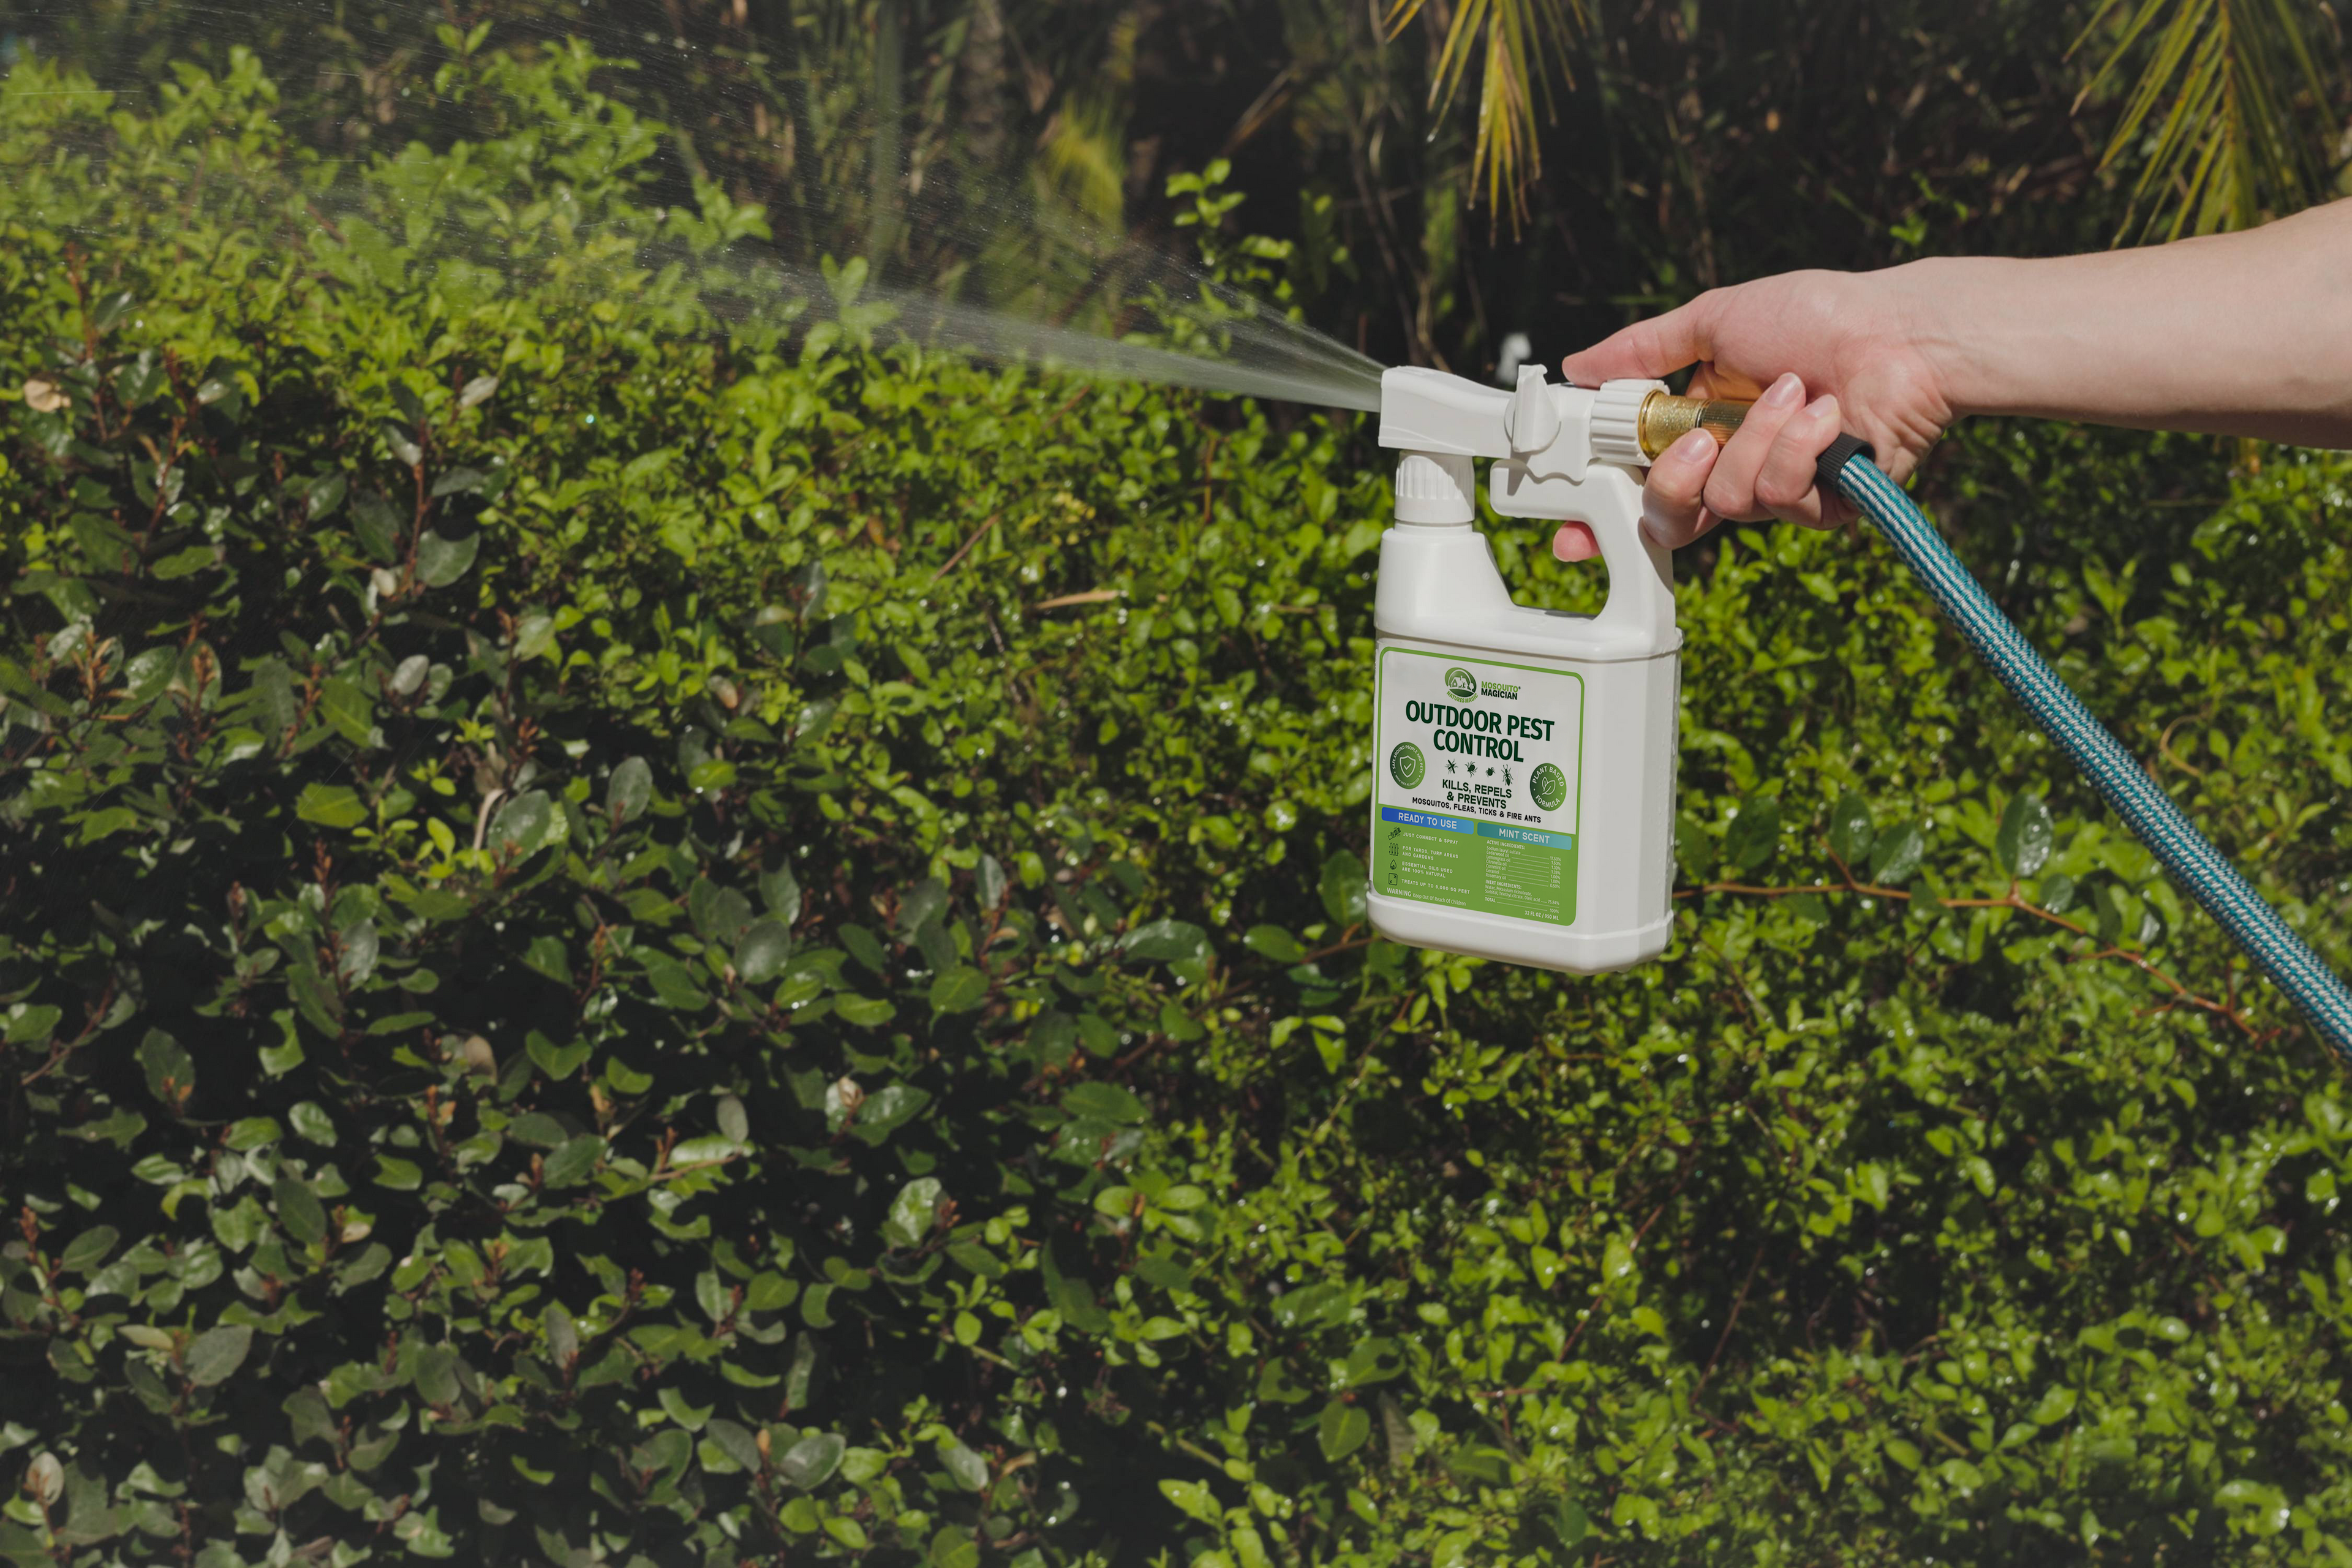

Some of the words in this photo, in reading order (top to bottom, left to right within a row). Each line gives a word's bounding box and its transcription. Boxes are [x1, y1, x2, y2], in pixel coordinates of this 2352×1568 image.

[1447, 691, 1464, 703] NATURES
[1465, 693, 1478, 703] MAGIC
[1481, 688, 1517, 700] MAGICIAN
[1406, 700, 1502, 734] OUTDOOR
[1507, 715, 1555, 741] PEST
[1394, 745, 1405, 758] AROUND
[1405, 745, 1418, 754] PEOPLE
[1434, 729, 1524, 762] CONTROL
[1532, 766, 1547, 784] PLANT
[1549, 766, 1564, 786] BASED
[1442, 779, 1471, 793] KILLS,
[1475, 784, 1512, 798] REPELS
[1412, 797, 1451, 810] MOSQUITOS,
[1454, 804, 1476, 814] FLEAS,
[1479, 808, 1497, 816] TICKS
[1447, 792, 1454, 801] &
[1458, 793, 1506, 809] PREVENTS
[1535, 795, 1560, 808] FORMULA
[1399, 812, 1424, 824] READY
[1427, 817, 1437, 826] TO
[1441, 819, 1457, 829] USE
[1499, 828, 1519, 839] MINT
[1522, 832, 1550, 844] SCENT
[1387, 887, 1411, 897] WARNING
